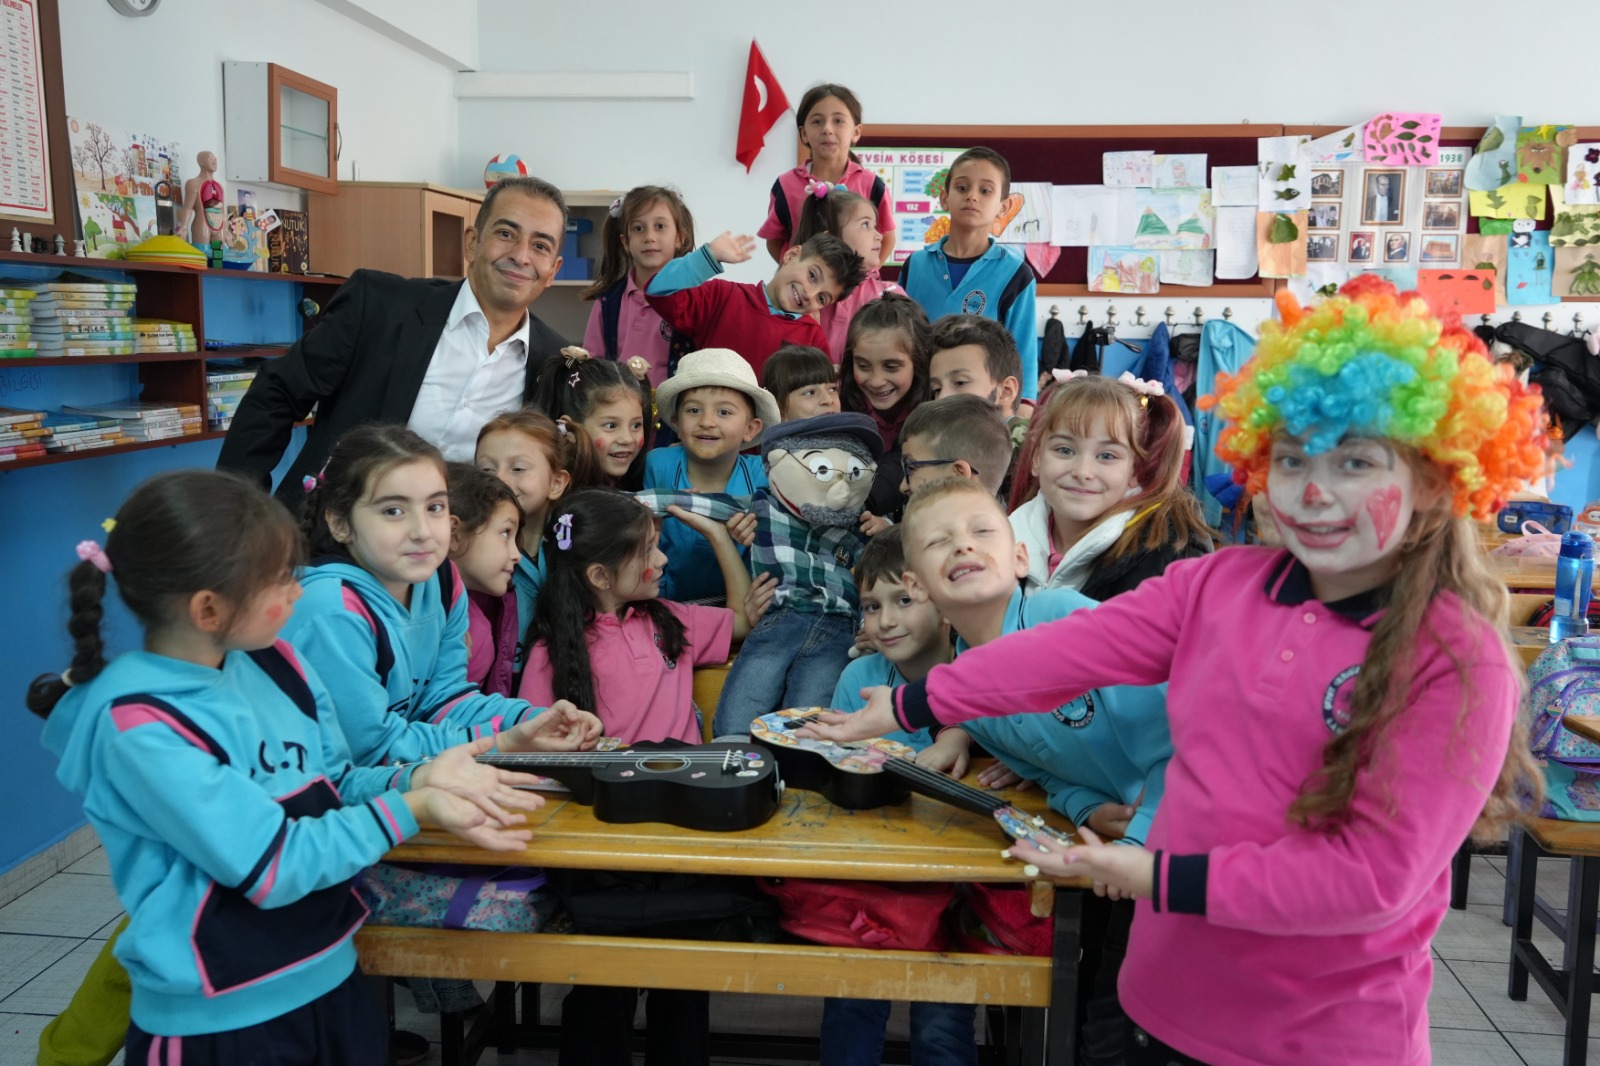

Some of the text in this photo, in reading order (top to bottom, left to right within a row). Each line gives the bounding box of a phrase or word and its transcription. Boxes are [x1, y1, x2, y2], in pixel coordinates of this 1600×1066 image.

[857, 151, 944, 165] EVSİM KÖŞESİ
[1440, 153, 1463, 163] 1938
[282, 219, 305, 231] NUTUK
[271, 234, 280, 268] NUTUK
[1070, 711, 1094, 728] SAMSUN
